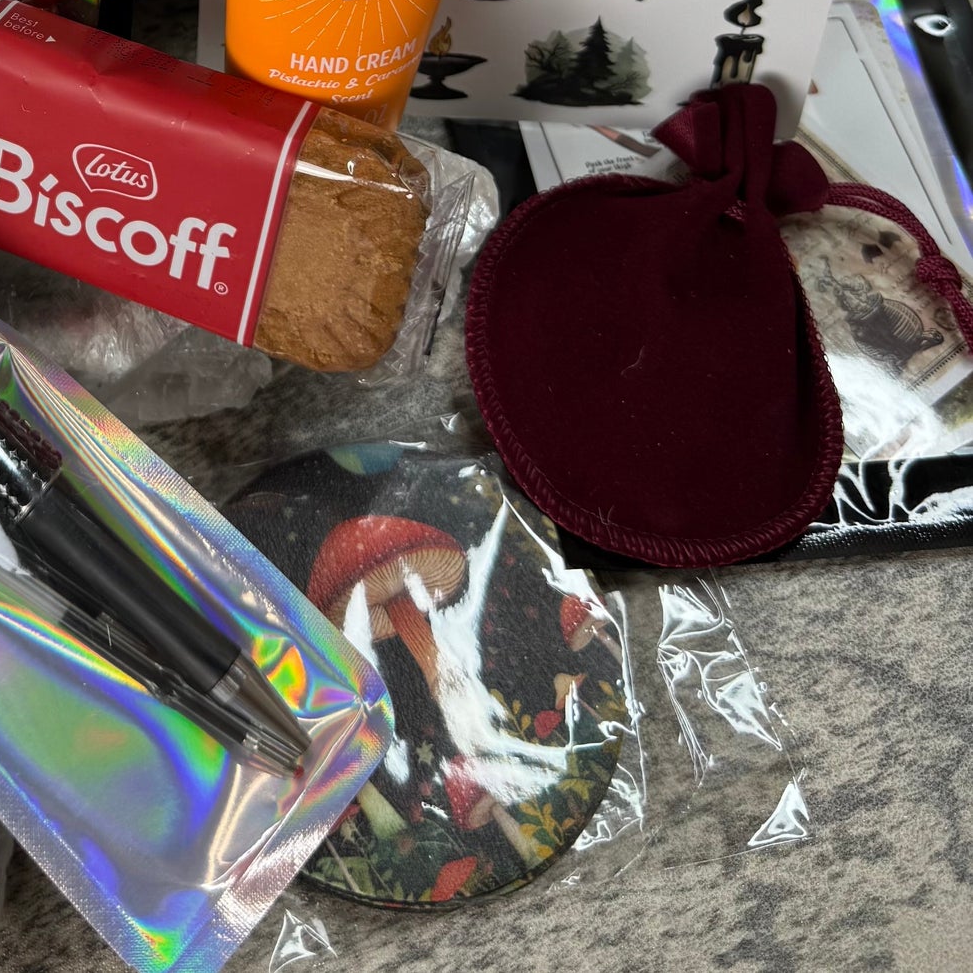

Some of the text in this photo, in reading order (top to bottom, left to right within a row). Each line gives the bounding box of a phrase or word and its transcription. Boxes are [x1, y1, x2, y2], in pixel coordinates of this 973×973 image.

[4, 20, 45, 40] before
[10, 12, 39, 28] Best
[289, 38, 418, 74] HAND CREAM
[268, 68, 341, 89] Pistachio
[345, 78, 359, 90] &
[331, 89, 374, 106] Scent
[84, 153, 150, 189] Lotus
